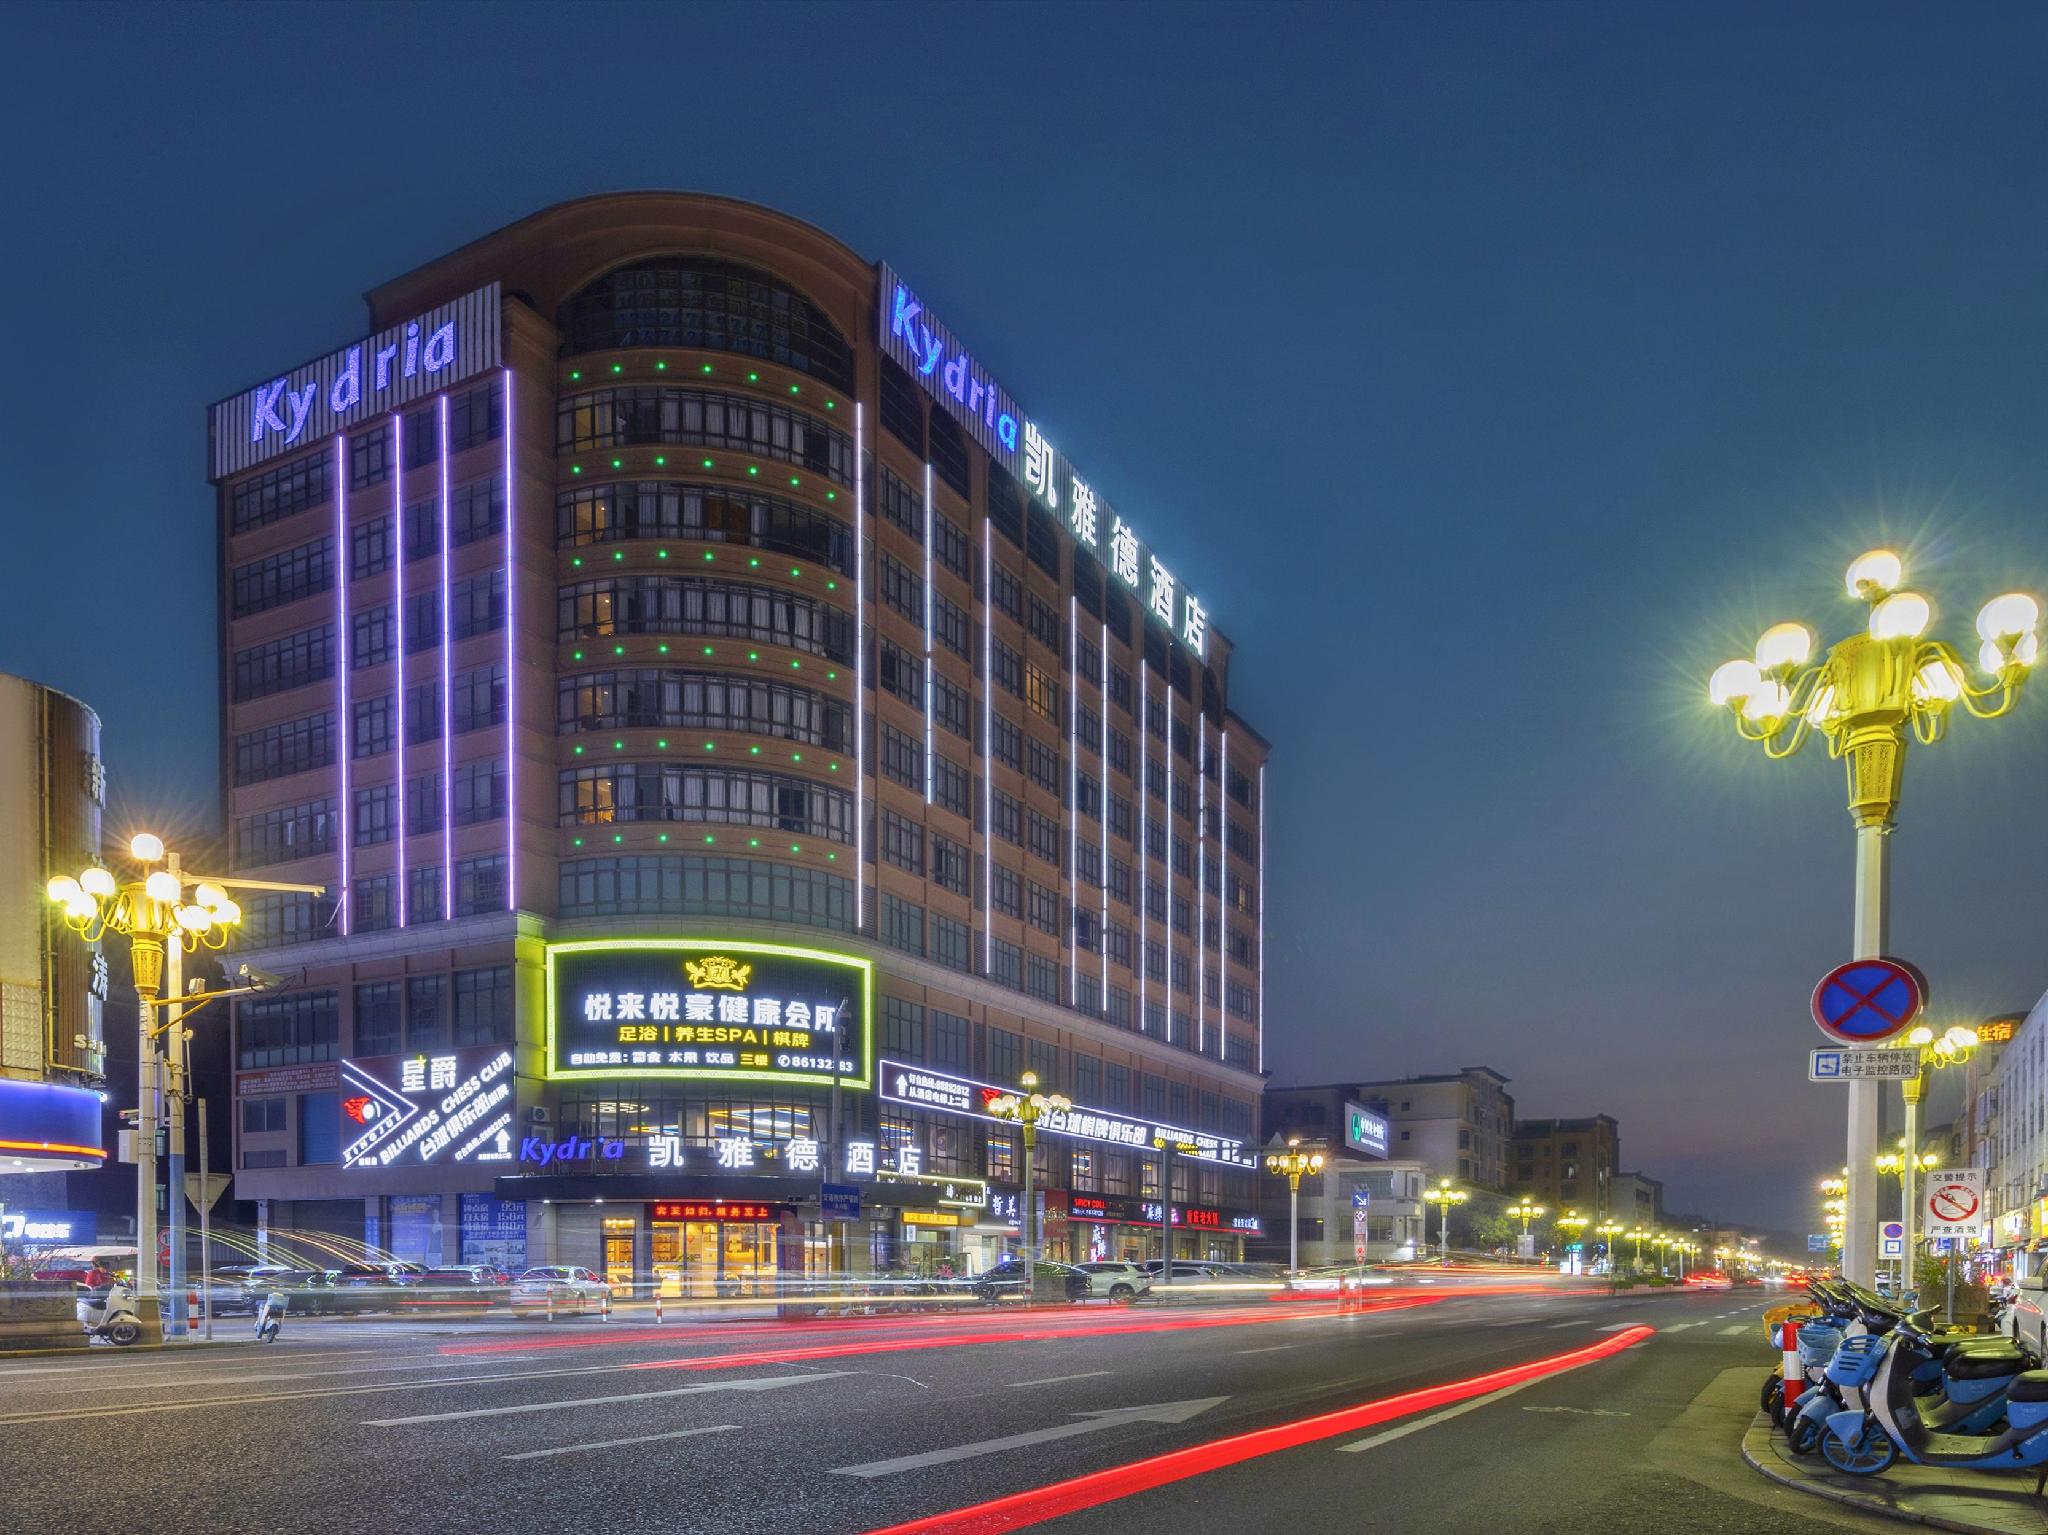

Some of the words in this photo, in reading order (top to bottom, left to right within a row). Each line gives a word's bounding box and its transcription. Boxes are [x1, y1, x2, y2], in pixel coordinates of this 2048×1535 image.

[253, 321, 456, 444] Kydria
[893, 284, 1018, 451] Kydria
[1024, 421, 1208, 656] 凯雅德酒店
[619, 1026, 657, 1042] 足浴
[773, 1031, 809, 1048] 棋牌
[1841, 1064, 1913, 1076] 电子监控路段
[1842, 1053, 1913, 1063] 禁止车辆停放
[379, 1109, 440, 1165] BILLIARDS
[441, 1075, 481, 1114] CHESS
[480, 1051, 512, 1082] CLUB
[648, 1133, 922, 1176] 凯雅德酒店
